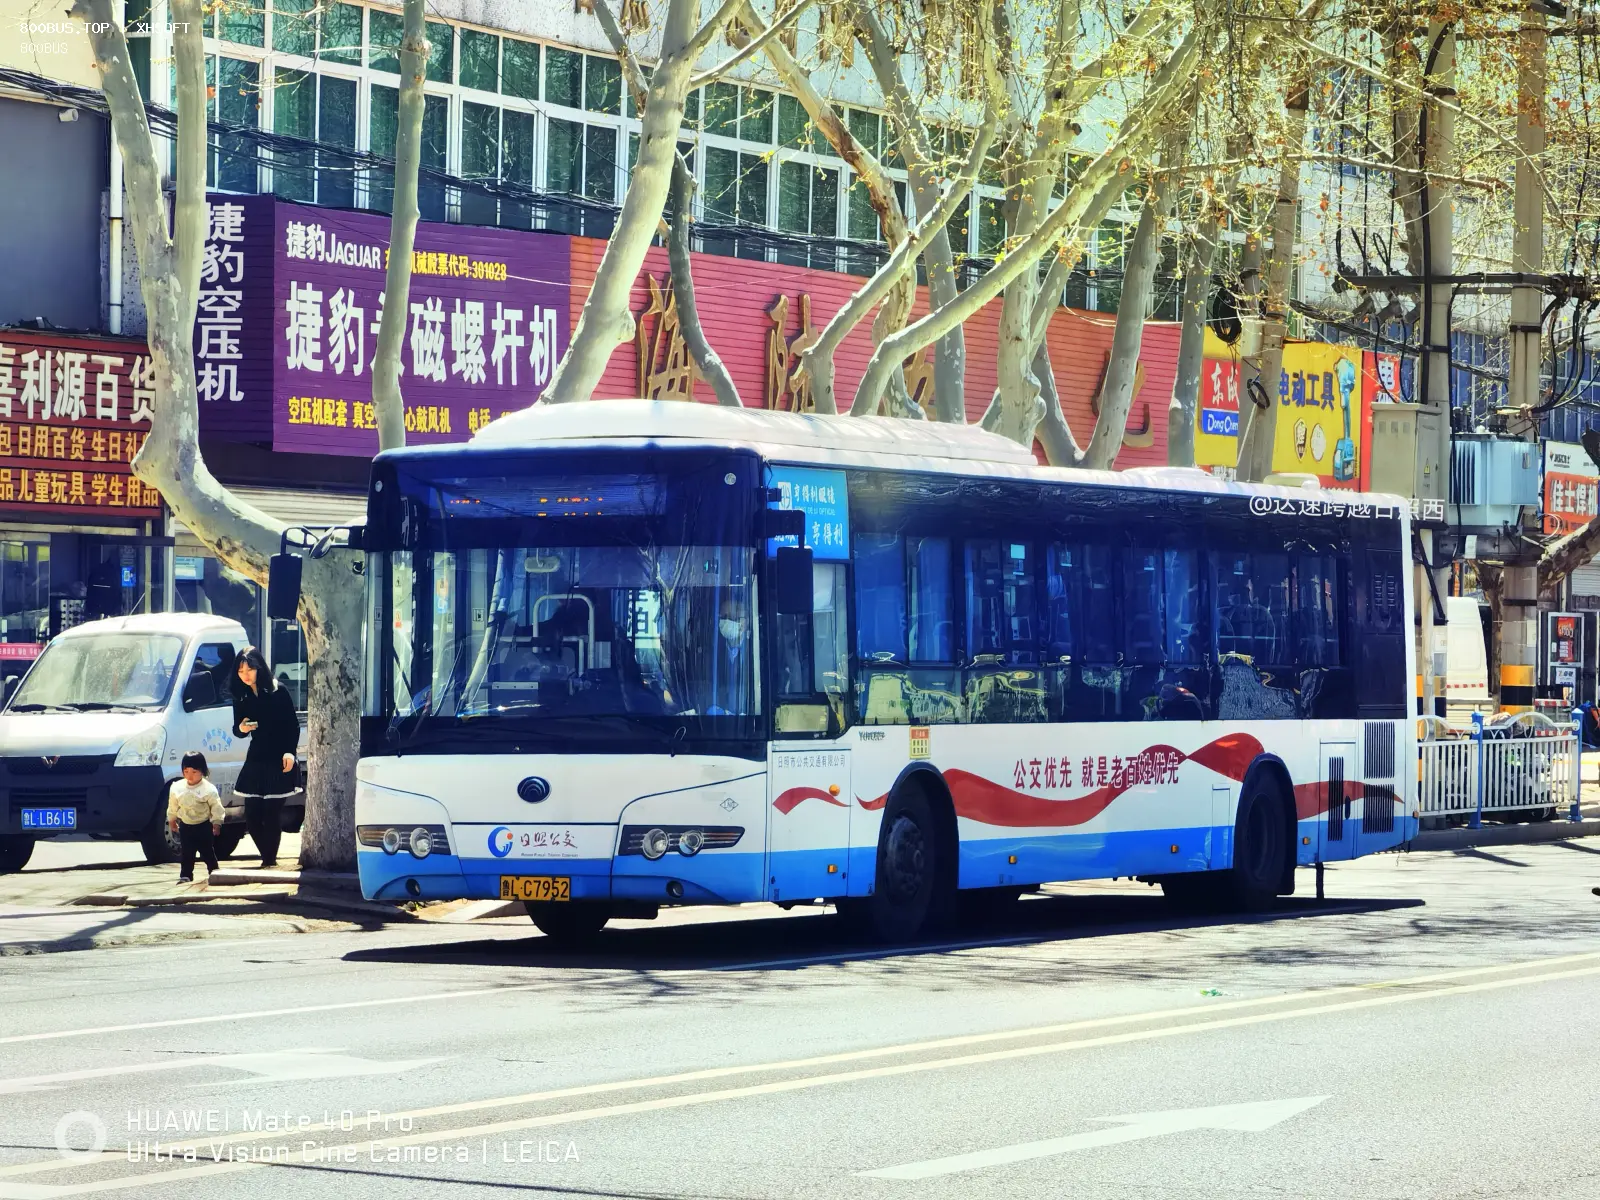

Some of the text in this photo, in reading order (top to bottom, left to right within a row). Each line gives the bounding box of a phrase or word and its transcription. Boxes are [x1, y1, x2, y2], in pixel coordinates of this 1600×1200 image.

[385, 249, 508, 281] 机械股票代码:301028
[197, 201, 246, 402] 捷豹空压机
[1278, 367, 1335, 412] 电动工具
[288, 396, 348, 428] 空压机配套
[353, 401, 379, 430] 真空
[403, 405, 452, 434] 心鼓风机
[1207, 413, 1239, 433] DongChen
[18, 425, 87, 461] 日用百货
[91, 430, 150, 462] 生日礼
[18, 468, 87, 506] 儿童玩具
[1013, 751, 1180, 790] 公交优先 就是老百姓优先
